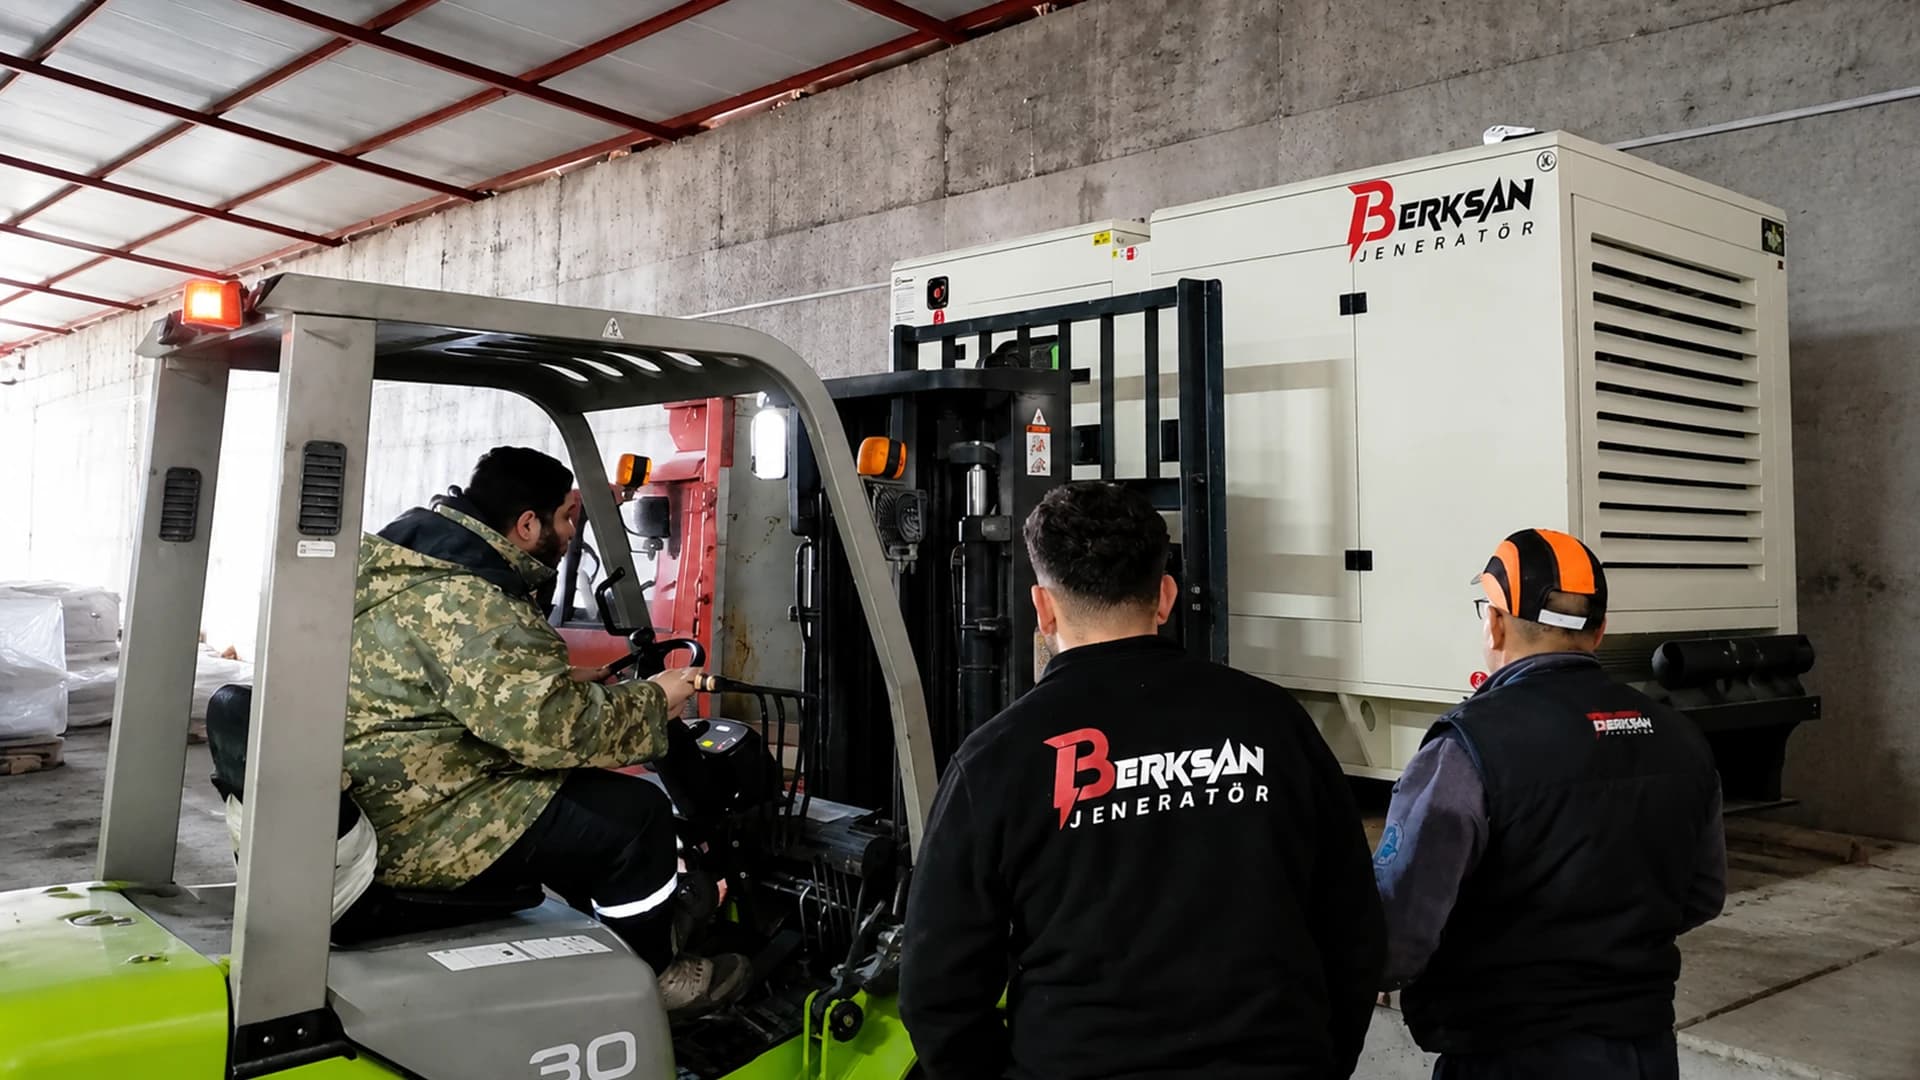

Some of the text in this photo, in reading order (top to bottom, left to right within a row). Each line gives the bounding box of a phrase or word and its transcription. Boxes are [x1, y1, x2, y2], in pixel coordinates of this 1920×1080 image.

[1347, 177, 1534, 263] BERKSAN
[1359, 221, 1534, 262] JENERATÖR
[1043, 728, 1264, 830] BERKSAN
[1070, 782, 1269, 828] JENERATÖR
[529, 1031, 637, 1080] 30
